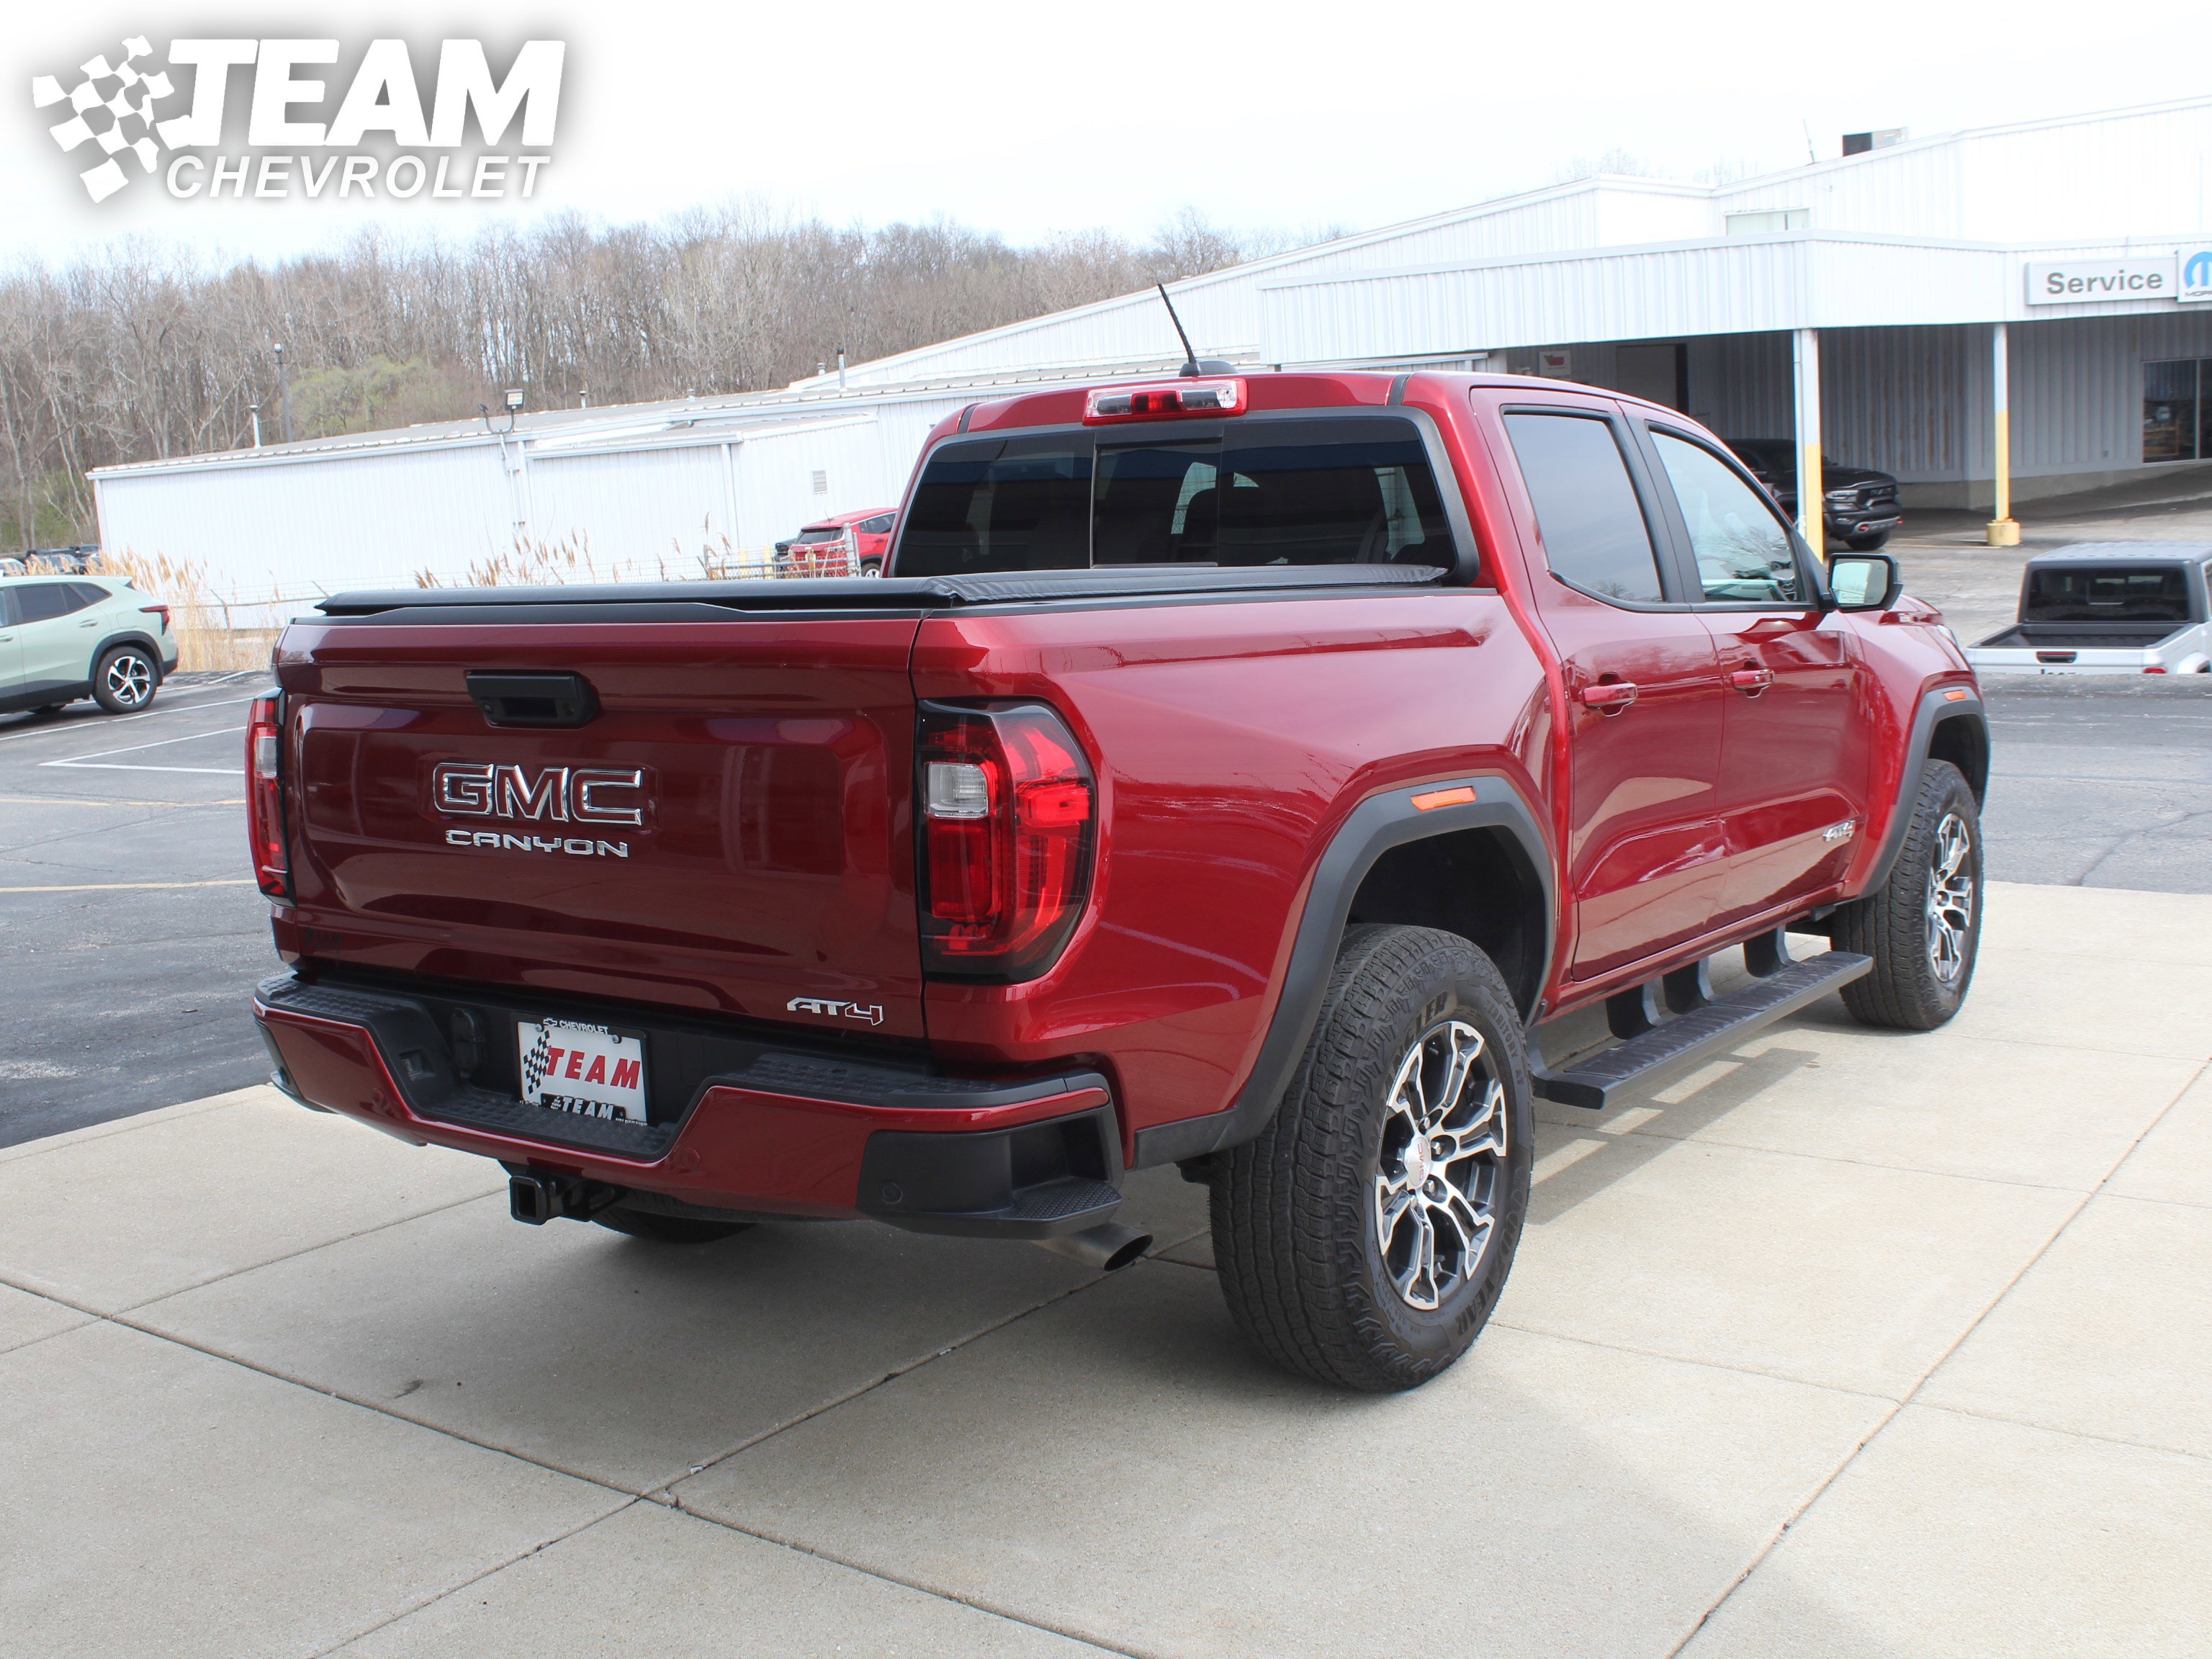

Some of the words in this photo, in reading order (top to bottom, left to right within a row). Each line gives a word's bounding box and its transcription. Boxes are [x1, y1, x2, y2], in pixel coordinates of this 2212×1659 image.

[2046, 269, 2163, 295] Service
[433, 763, 642, 826] GMC
[446, 830, 629, 858] CANYON
[787, 997, 884, 1026] AT4
[559, 1020, 608, 1035] CHEVROLET
[547, 1047, 641, 1090] TEAM
[562, 1096, 614, 1120] TEAM
